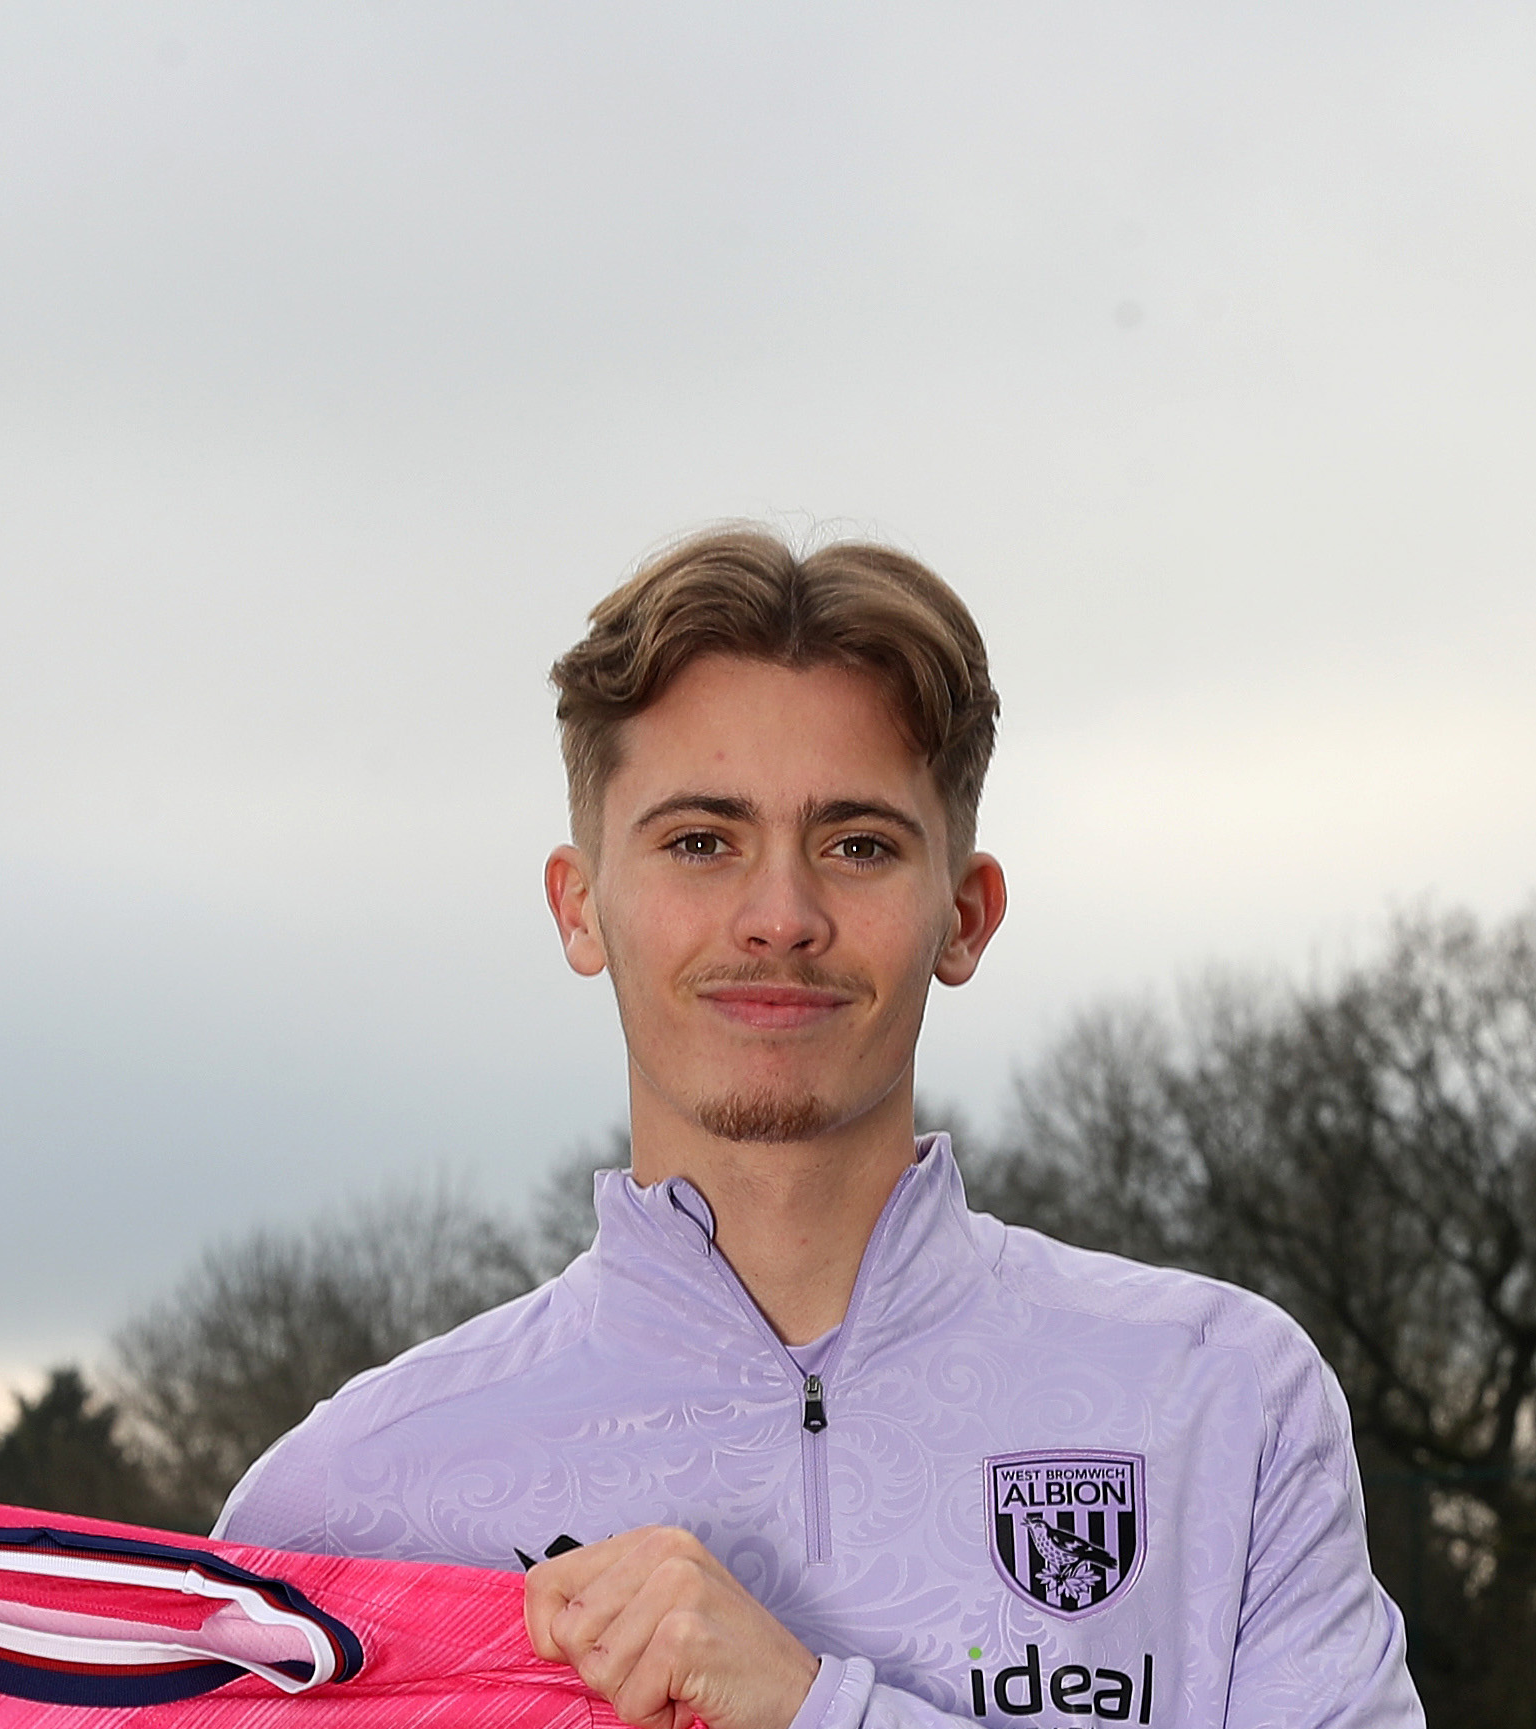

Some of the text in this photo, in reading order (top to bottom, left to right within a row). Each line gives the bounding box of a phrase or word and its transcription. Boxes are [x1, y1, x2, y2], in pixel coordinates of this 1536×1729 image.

[1001, 1468, 1125, 1482] WEST BROMWICH
[1002, 1480, 1127, 1508] ALBION
[969, 1643, 1153, 1725] ideal
